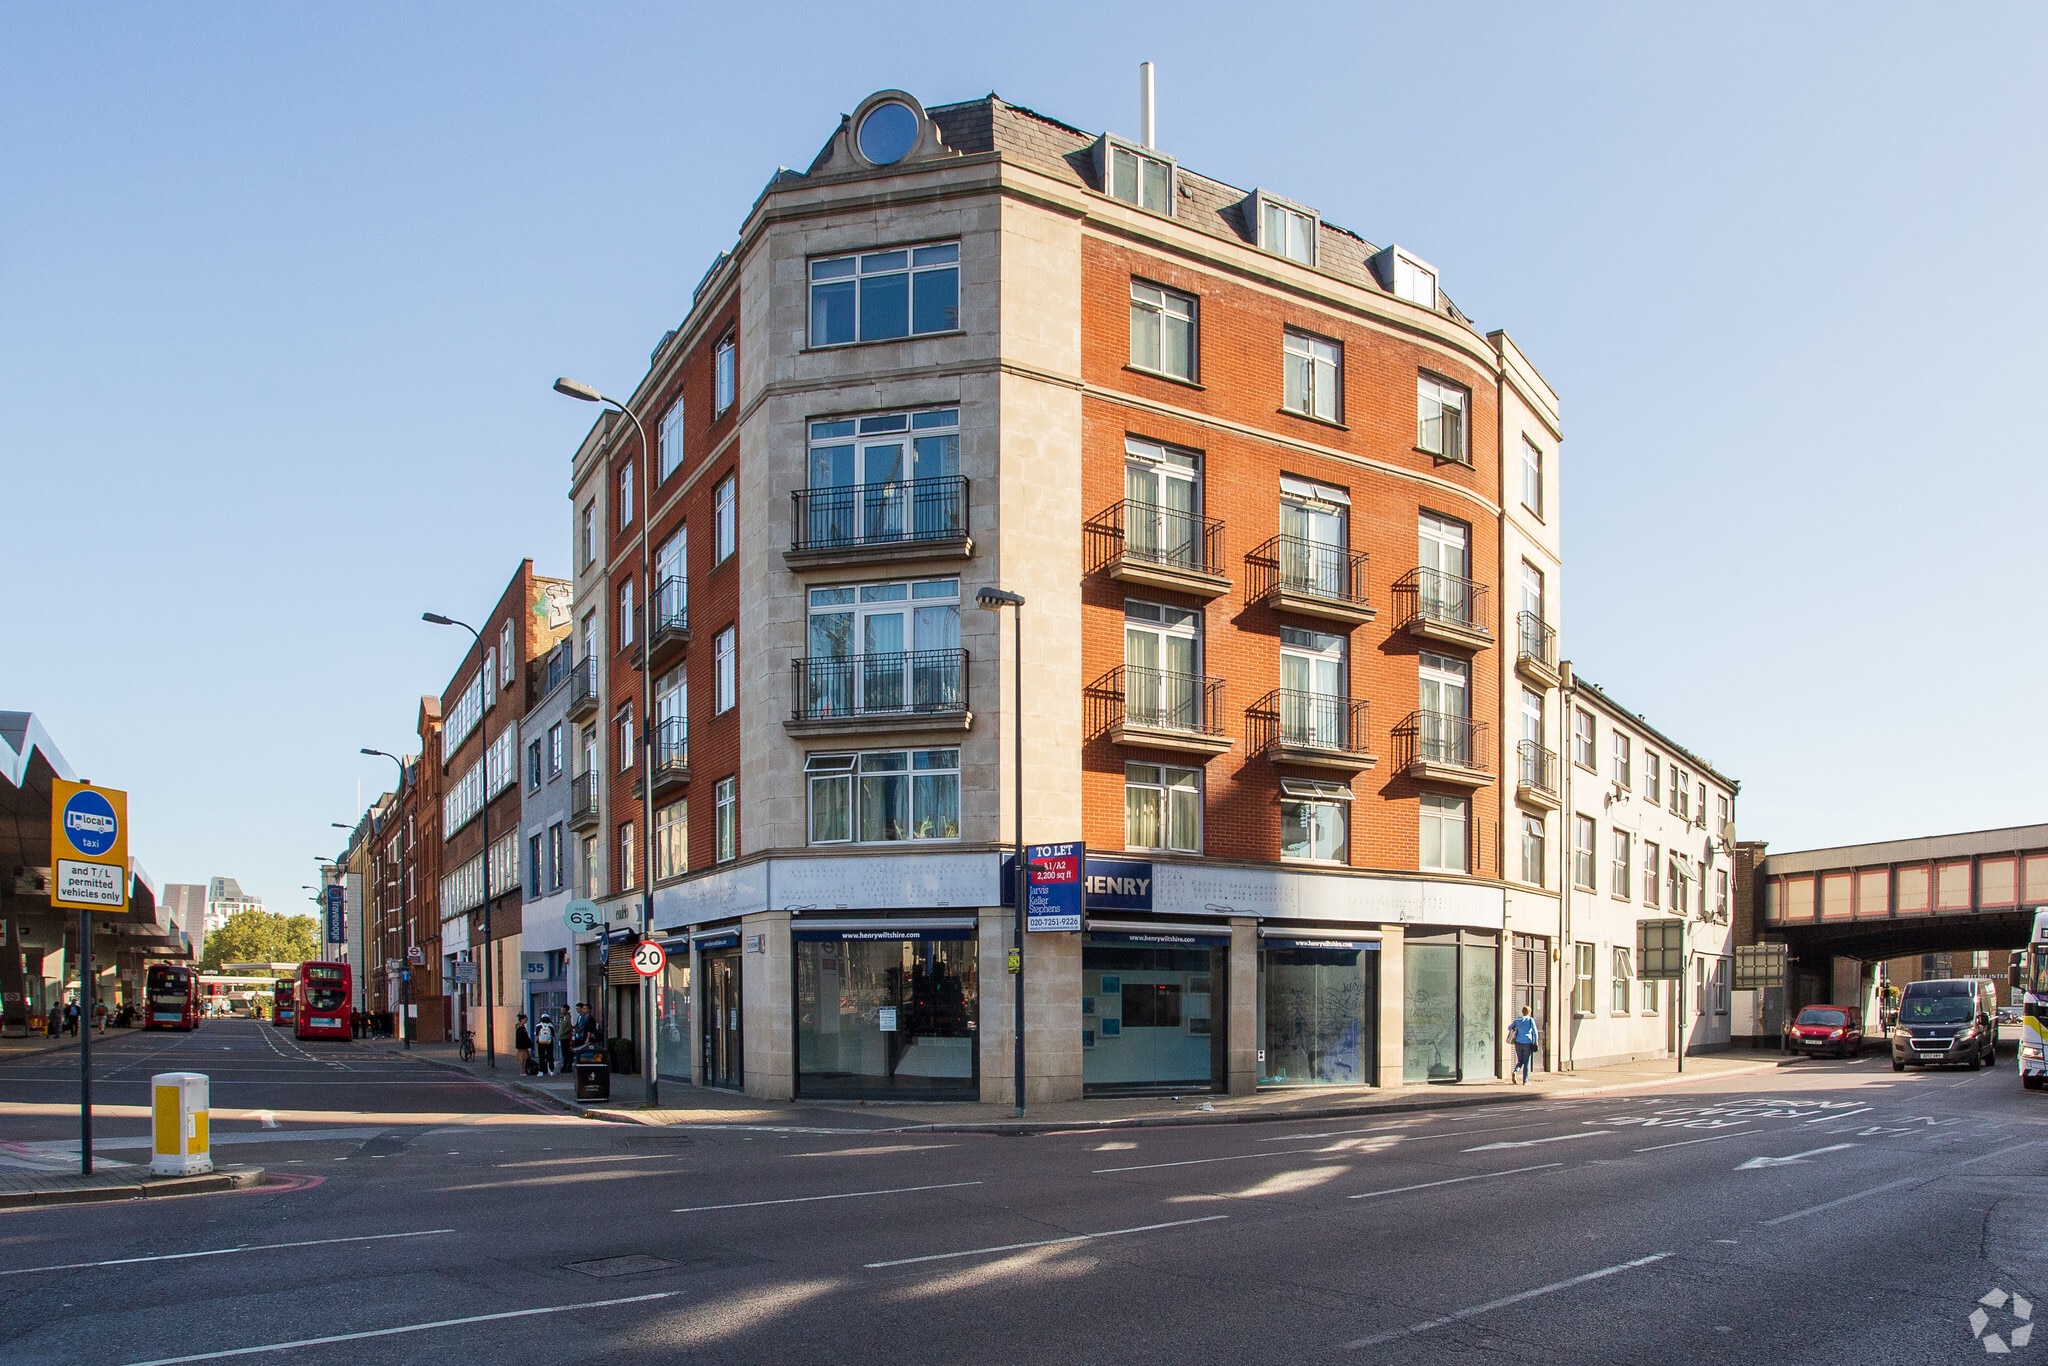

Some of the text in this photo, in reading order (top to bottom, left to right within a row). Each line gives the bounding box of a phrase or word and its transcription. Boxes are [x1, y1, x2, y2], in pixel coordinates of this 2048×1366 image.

[83, 815, 105, 826] local
[82, 838, 100, 848] taxi
[1036, 845, 1073, 857] TO LET
[71, 867, 89, 875] and
[1037, 870, 1072, 881] 2,200 sq ft
[68, 878, 113, 889] permitted
[61, 888, 120, 902] vehicles only
[1028, 896, 1049, 905] Keller
[1028, 905, 1061, 915] Stephens
[570, 913, 595, 924] 63
[1030, 917, 1078, 927] 020-7251-9226
[842, 931, 920, 940] www.henrywiltshire.com
[1129, 934, 1196, 944] www.henrywiltshire.com
[1295, 940, 1353, 948] www.henrywiltshire.com
[637, 951, 660, 966] 20
[527, 963, 545, 973] 55
